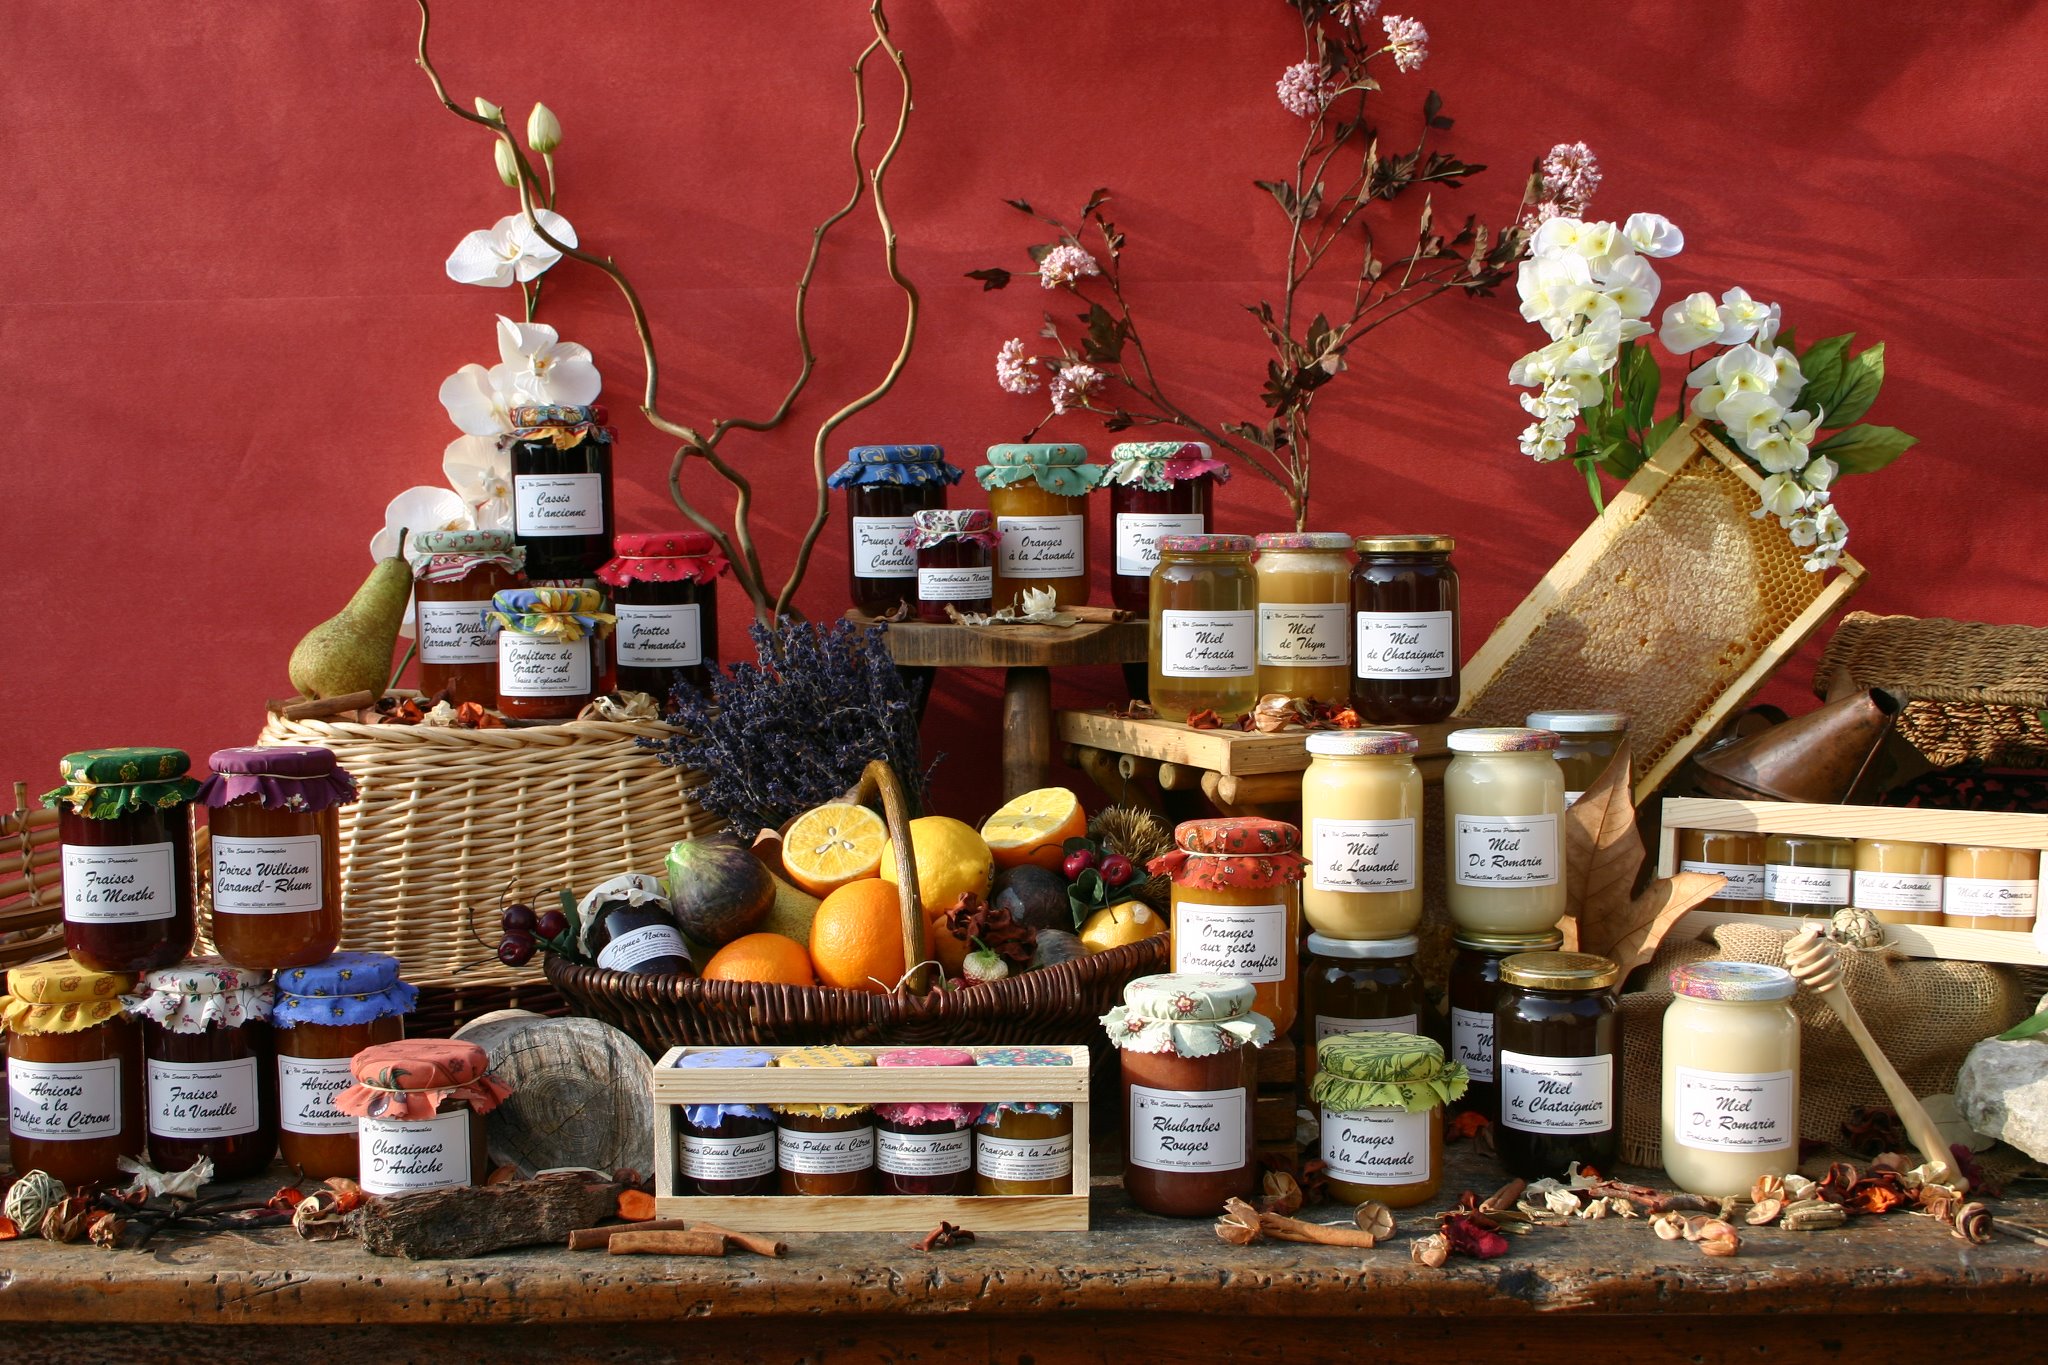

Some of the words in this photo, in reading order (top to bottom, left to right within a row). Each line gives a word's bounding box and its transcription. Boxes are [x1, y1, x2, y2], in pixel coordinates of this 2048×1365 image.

[537, 492, 570, 505] Cassis
[529, 508, 534, 517] à
[538, 507, 586, 517] l'ancienne
[862, 534, 893, 546] Prunes
[1021, 535, 1062, 550] Oranges
[893, 546, 902, 555] la
[1009, 550, 1015, 560] à
[1019, 550, 1028, 560] la
[1032, 550, 1075, 560] Lavande
[871, 555, 914, 568] Cannelle
[424, 623, 451, 634] Poires
[632, 624, 669, 639] Griottes
[1288, 623, 1315, 634] Miel
[639, 639, 686, 650] Amandes
[1195, 632, 1224, 644] Miel
[1280, 639, 1291, 648] de
[1297, 637, 1326, 651] Thym
[1390, 633, 1419, 644] Miel
[510, 649, 556, 663] Confiture
[560, 650, 572, 660] de
[1185, 647, 1233, 659] d'Acacia
[1367, 649, 1378, 659] de
[1382, 648, 1444, 663] Chataignier
[1347, 843, 1379, 856] Miel
[1488, 838, 1520, 851] Miel
[1330, 860, 1342, 871] de
[1346, 859, 1399, 872] Lavande
[1469, 854, 1485, 866] De
[1491, 855, 1542, 868] Romarin
[219, 861, 252, 875] Poires
[256, 863, 309, 876] William
[86, 871, 134, 887] Fraises
[1892, 880, 1931, 890] Lavande
[76, 889, 81, 902] à
[87, 890, 99, 902] la
[103, 886, 154, 903] Menthe
[1958, 887, 1978, 898] Miel
[1983, 890, 1994, 898] de
[1203, 924, 1253, 942] Oranges
[612, 938, 640, 958] Figues
[642, 932, 670, 940] Noires
[1200, 944, 1220, 952] aux
[1225, 943, 1256, 957] zests
[1241, 955, 1278, 972] confits
[29, 1083, 82, 1096] Abricots
[301, 1077, 352, 1090] Abricots
[1538, 1080, 1572, 1095] Miel
[170, 1087, 217, 1102] Fraises
[313, 1093, 321, 1104] à
[41, 1098, 48, 1111] à
[55, 1099, 68, 1111] la
[163, 1104, 169, 1116] à
[174, 1105, 186, 1117] la
[189, 1103, 237, 1118] Vanille
[1512, 1096, 1523, 1108] de
[1529, 1097, 1602, 1116] Chataignier
[1716, 1097, 1752, 1111] Miel
[14, 1107, 41, 1126] Pulpe
[46, 1114, 61, 1125] de
[68, 1111, 110, 1128] Citron
[1152, 1117, 1221, 1132] Rhubarbes
[1693, 1112, 1711, 1127] De
[1719, 1116, 1775, 1130] Romarin
[803, 1141, 831, 1154] Pulpe
[849, 1138, 870, 1150] Citron
[880, 1139, 926, 1152] Framboises
[930, 1142, 962, 1152] Nature
[1160, 1136, 1209, 1156] Rouges
[1342, 1129, 1394, 1149] Oranges
[372, 1139, 443, 1159] Chataignes
[702, 1146, 729, 1155] Bleues
[980, 1143, 1014, 1158] Oranges
[1018, 1149, 1024, 1157] à
[1029, 1149, 1039, 1157] la
[1330, 1146, 1335, 1159] à
[1339, 1149, 1351, 1162] la
[1355, 1151, 1414, 1165] Lavande
[374, 1158, 443, 1174] D'Ardèche
